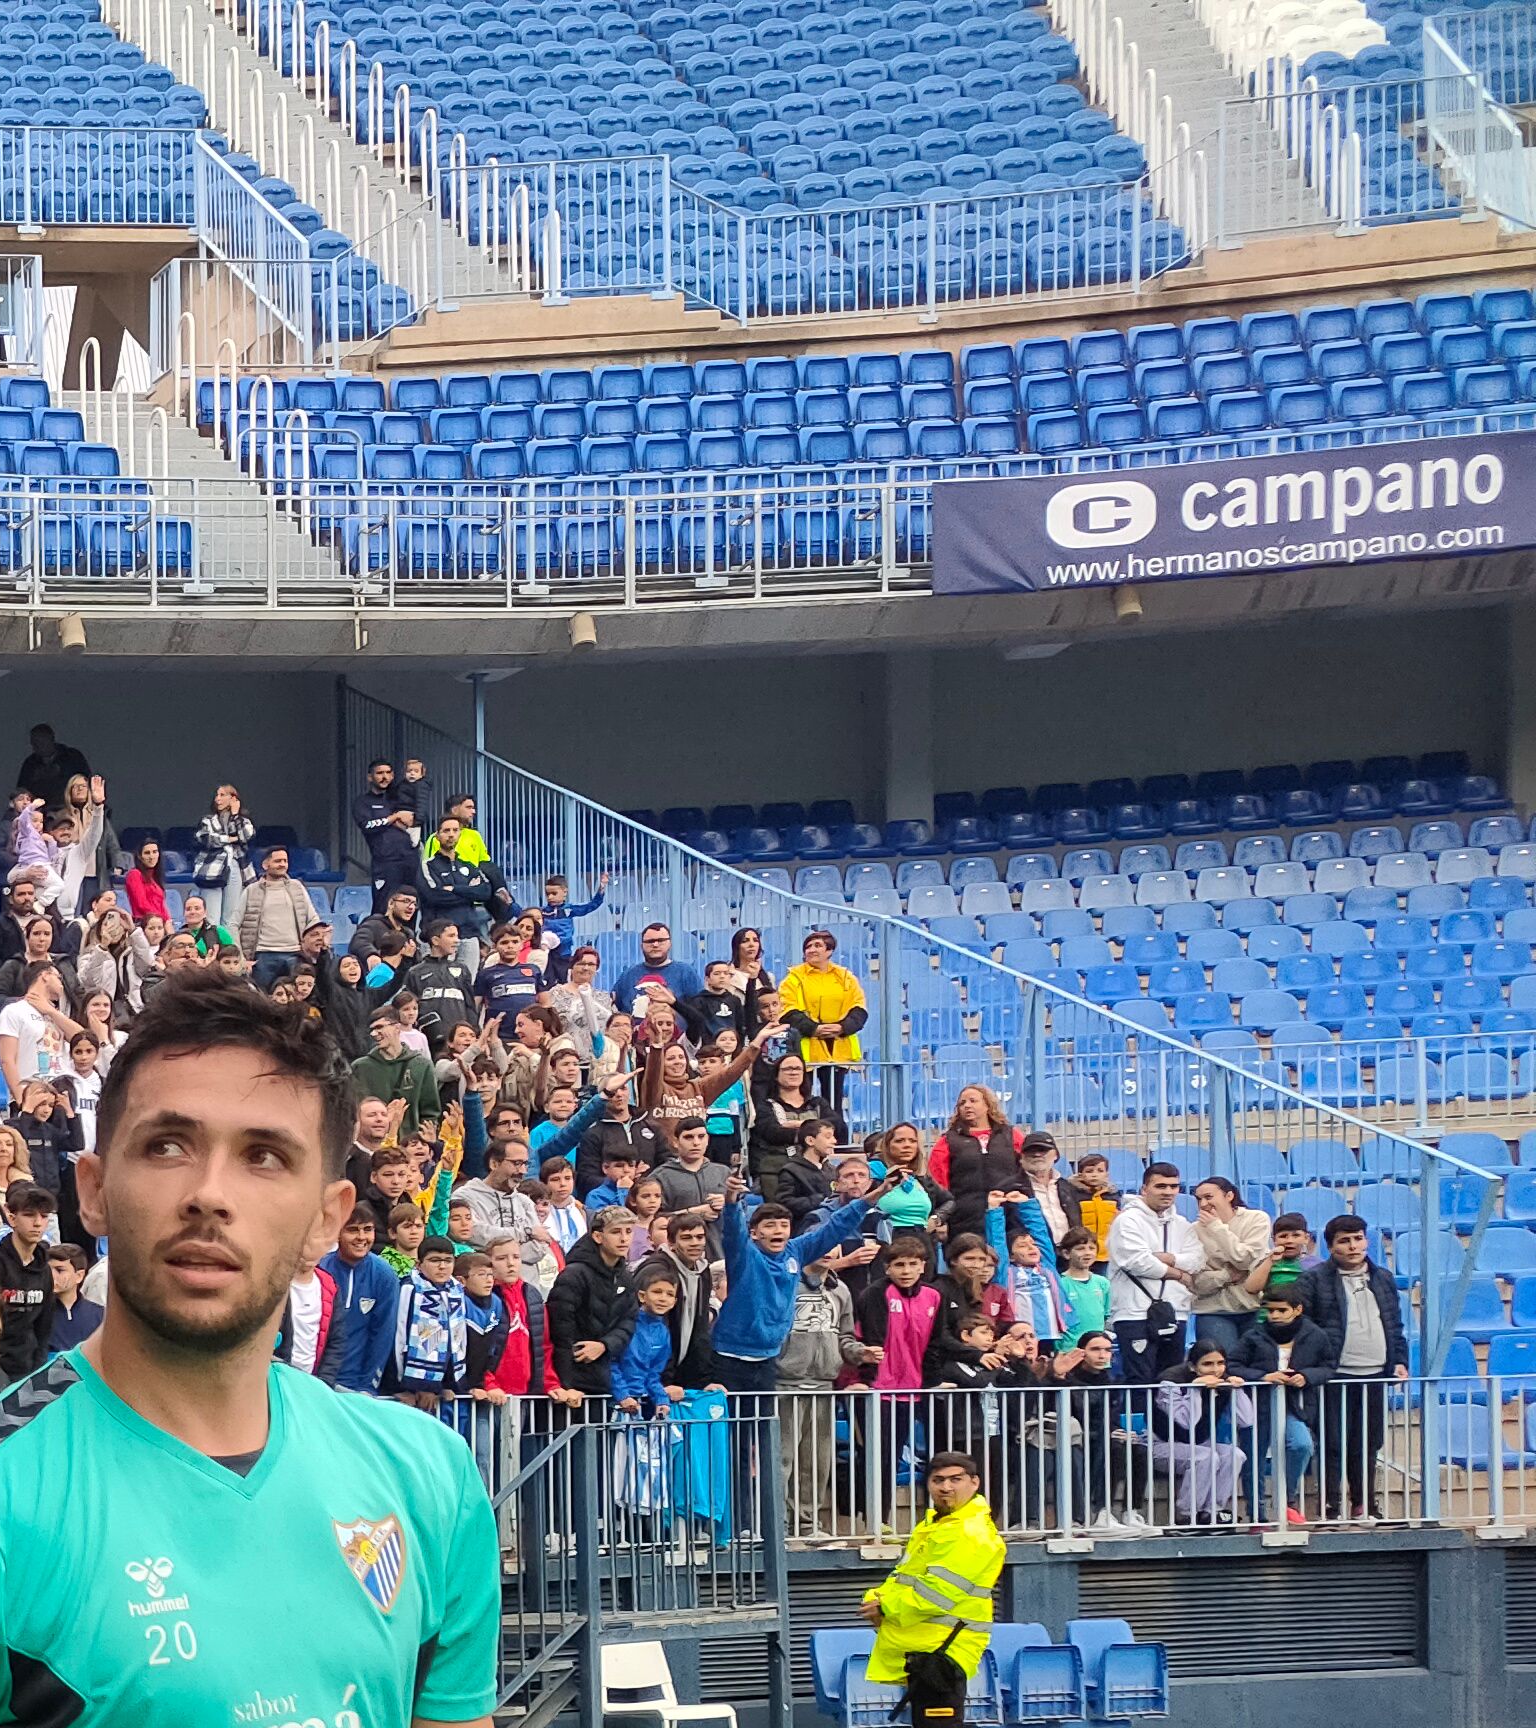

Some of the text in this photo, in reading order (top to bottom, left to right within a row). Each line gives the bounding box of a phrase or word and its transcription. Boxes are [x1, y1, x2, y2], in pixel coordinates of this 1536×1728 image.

[1181, 453, 1504, 534] campano
[1046, 525, 1505, 585] www.hermanoscampano.com
[889, 1298, 903, 1313] 20
[128, 1592, 190, 1617] hummel
[145, 1620, 197, 1666] 20
[234, 1690, 298, 1722] sabor
